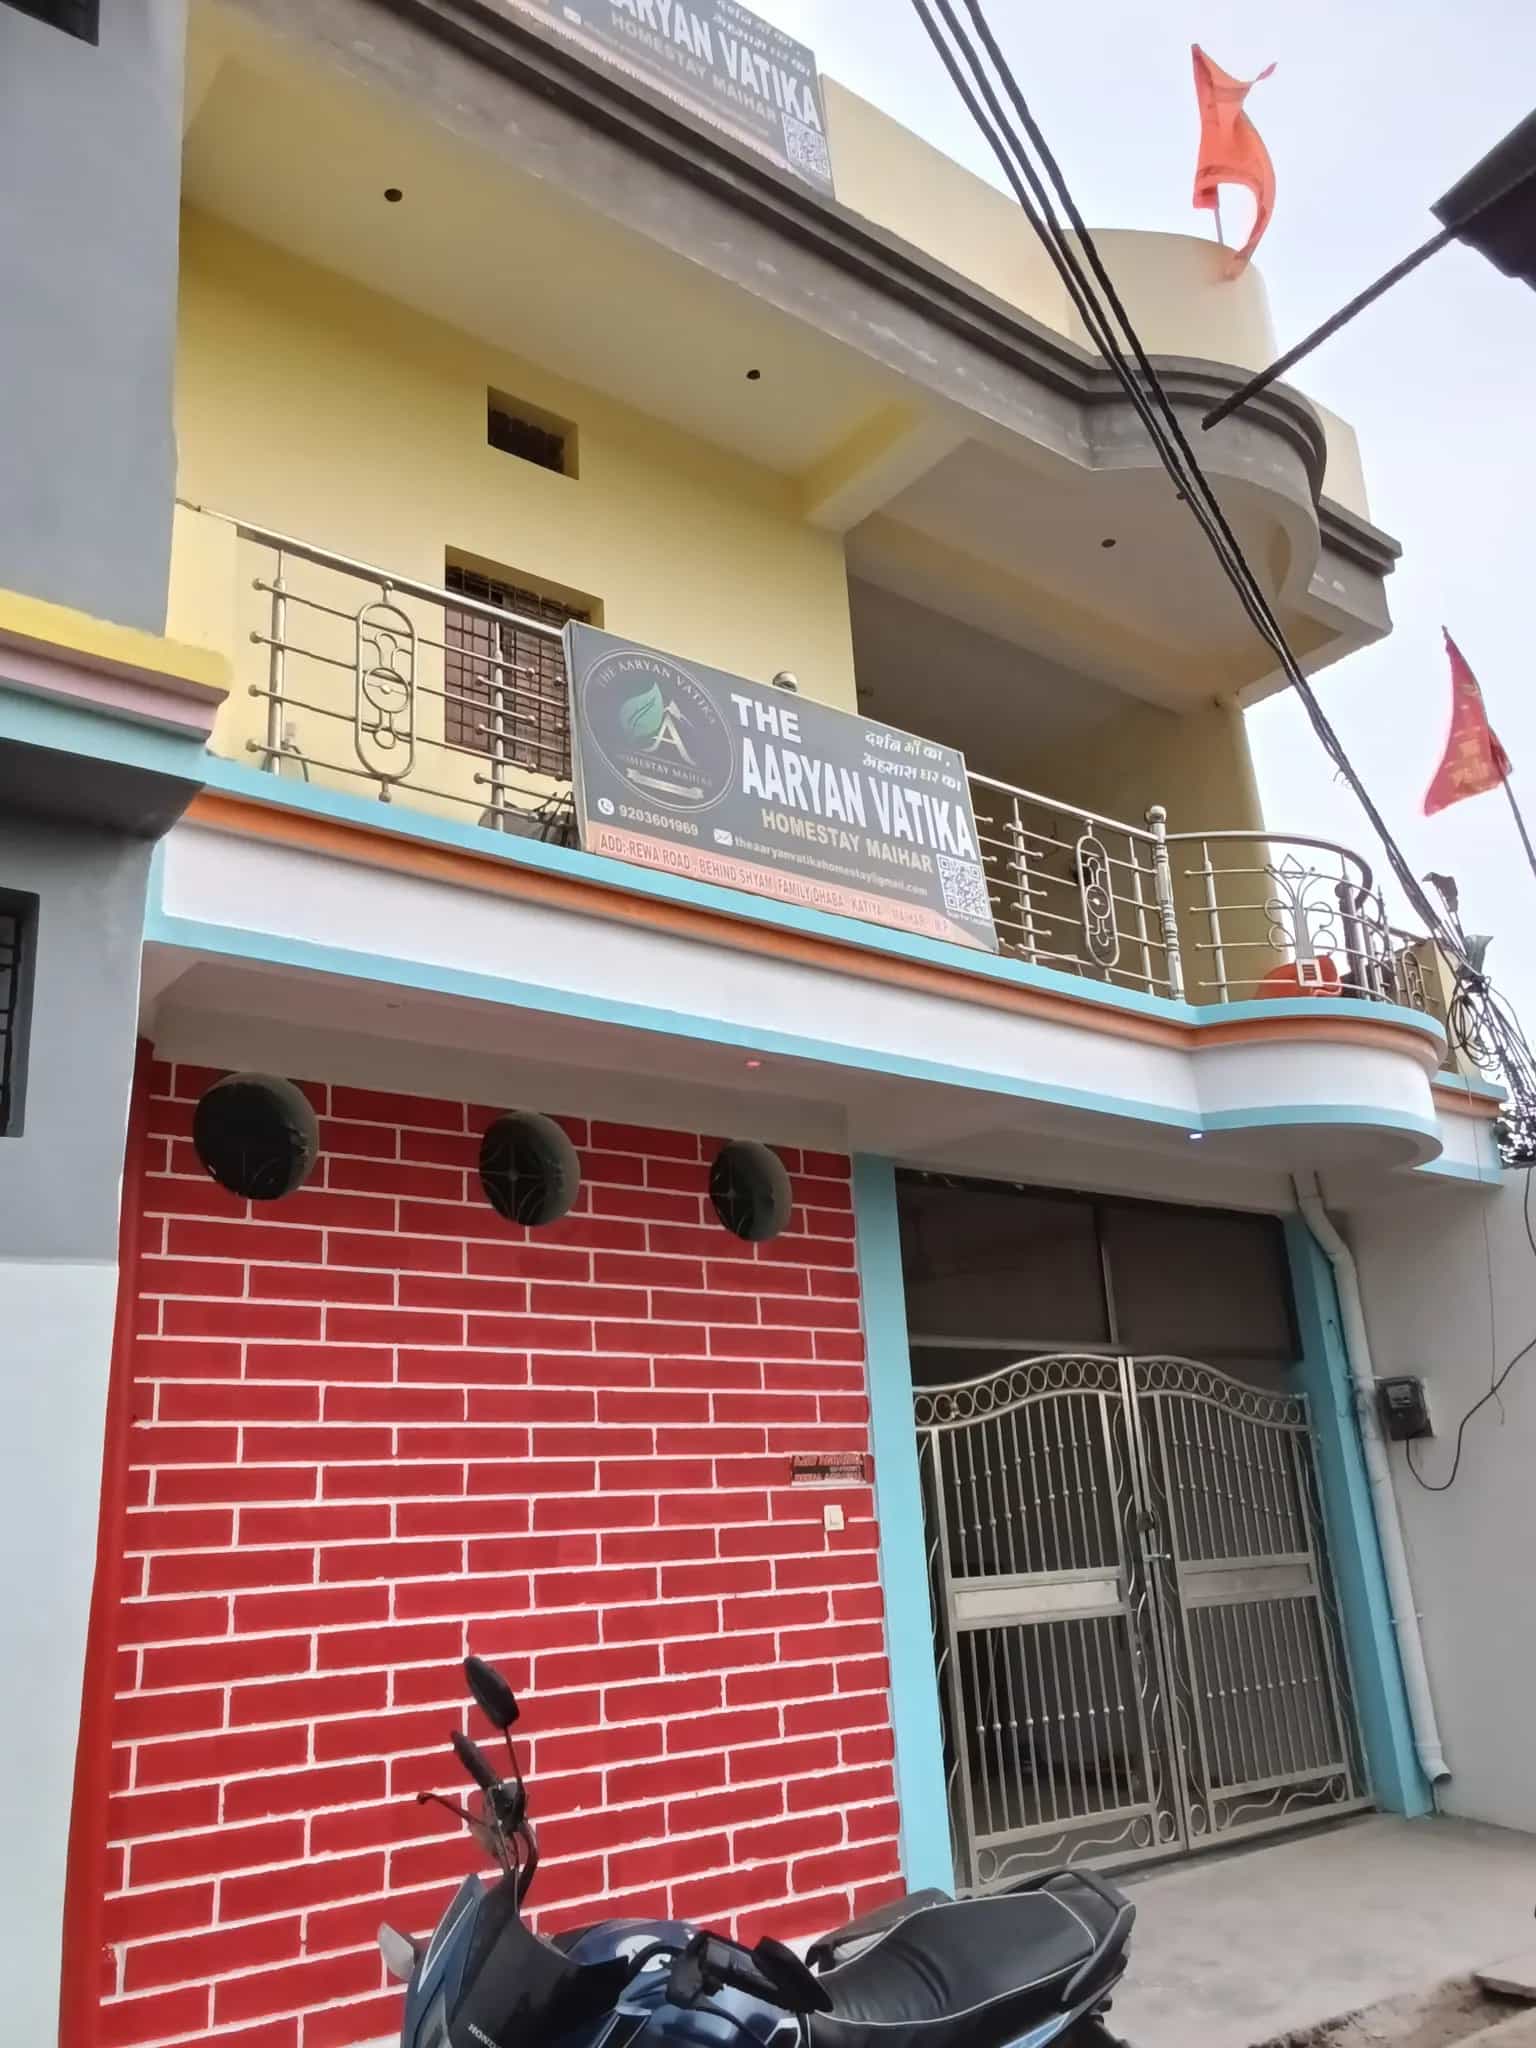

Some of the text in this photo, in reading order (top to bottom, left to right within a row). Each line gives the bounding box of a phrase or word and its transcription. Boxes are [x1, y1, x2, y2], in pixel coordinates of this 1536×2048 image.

[608, 0, 714, 65] RYAN
[718, 30, 822, 133] VATIKA
[731, 693, 802, 744] THE
[743, 737, 978, 861] AARYAN VATIKA
[761, 808, 934, 873] HOMESTAY MAIHAR
